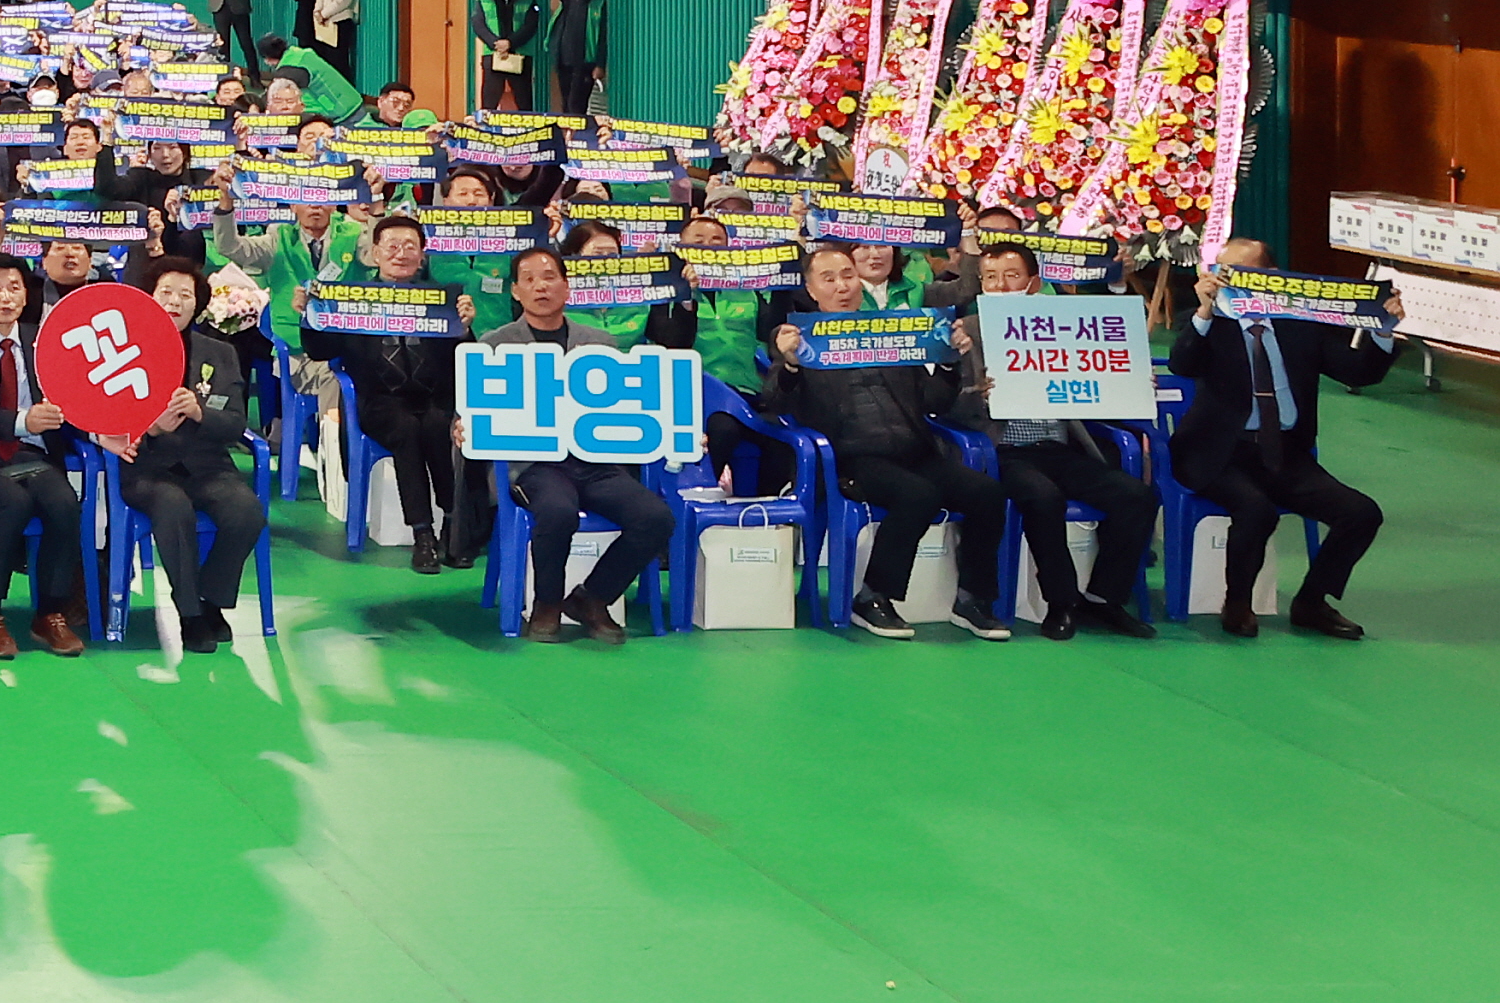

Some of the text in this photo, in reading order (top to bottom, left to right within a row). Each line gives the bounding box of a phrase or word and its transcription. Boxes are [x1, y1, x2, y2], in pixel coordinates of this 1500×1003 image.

[126, 102, 226, 120] 사천우주항공철도!
[139, 116, 210, 128] 제5차 국가철도망
[124, 124, 226, 141] 구축계획에 반영하라!
[241, 160, 354, 179] 사천우주항공철도!
[258, 172, 339, 188] 제5차 국가철도망
[242, 182, 357, 201] 구축계획에 반영하라!
[819, 196, 946, 217] 사천우주항공철도!
[126, 210, 139, 224] 및
[418, 210, 533, 225] 사천우주항공철도!
[837, 211, 926, 227] 제5차 국가철도망
[435, 226, 516, 237] 제5차 국가철도망
[818, 221, 946, 244] 구축계획에 반영하라!
[480, 238, 535, 252] 반영하라!
[319, 285, 446, 305] 사천우주항공철도!
[1229, 272, 1379, 300] 사천우주항공철도!
[337, 302, 427, 316] 제5차 국가철도망
[1251, 291, 1357, 312] 제5차 국가철도망
[317, 313, 448, 333] 구축계획에 반영하라!
[812, 317, 934, 336] 사천우주항공철도!
[1003, 315, 1128, 343] 사천-서울
[828, 335, 916, 350] 제5차 국가철도망
[60, 306, 149, 400] 꼭
[819, 347, 926, 365] 구축계획에 반영하라!
[1005, 348, 1132, 373] 2시간 30분
[1046, 379, 1101, 404] 실현!
[465, 348, 694, 458] 반영!
